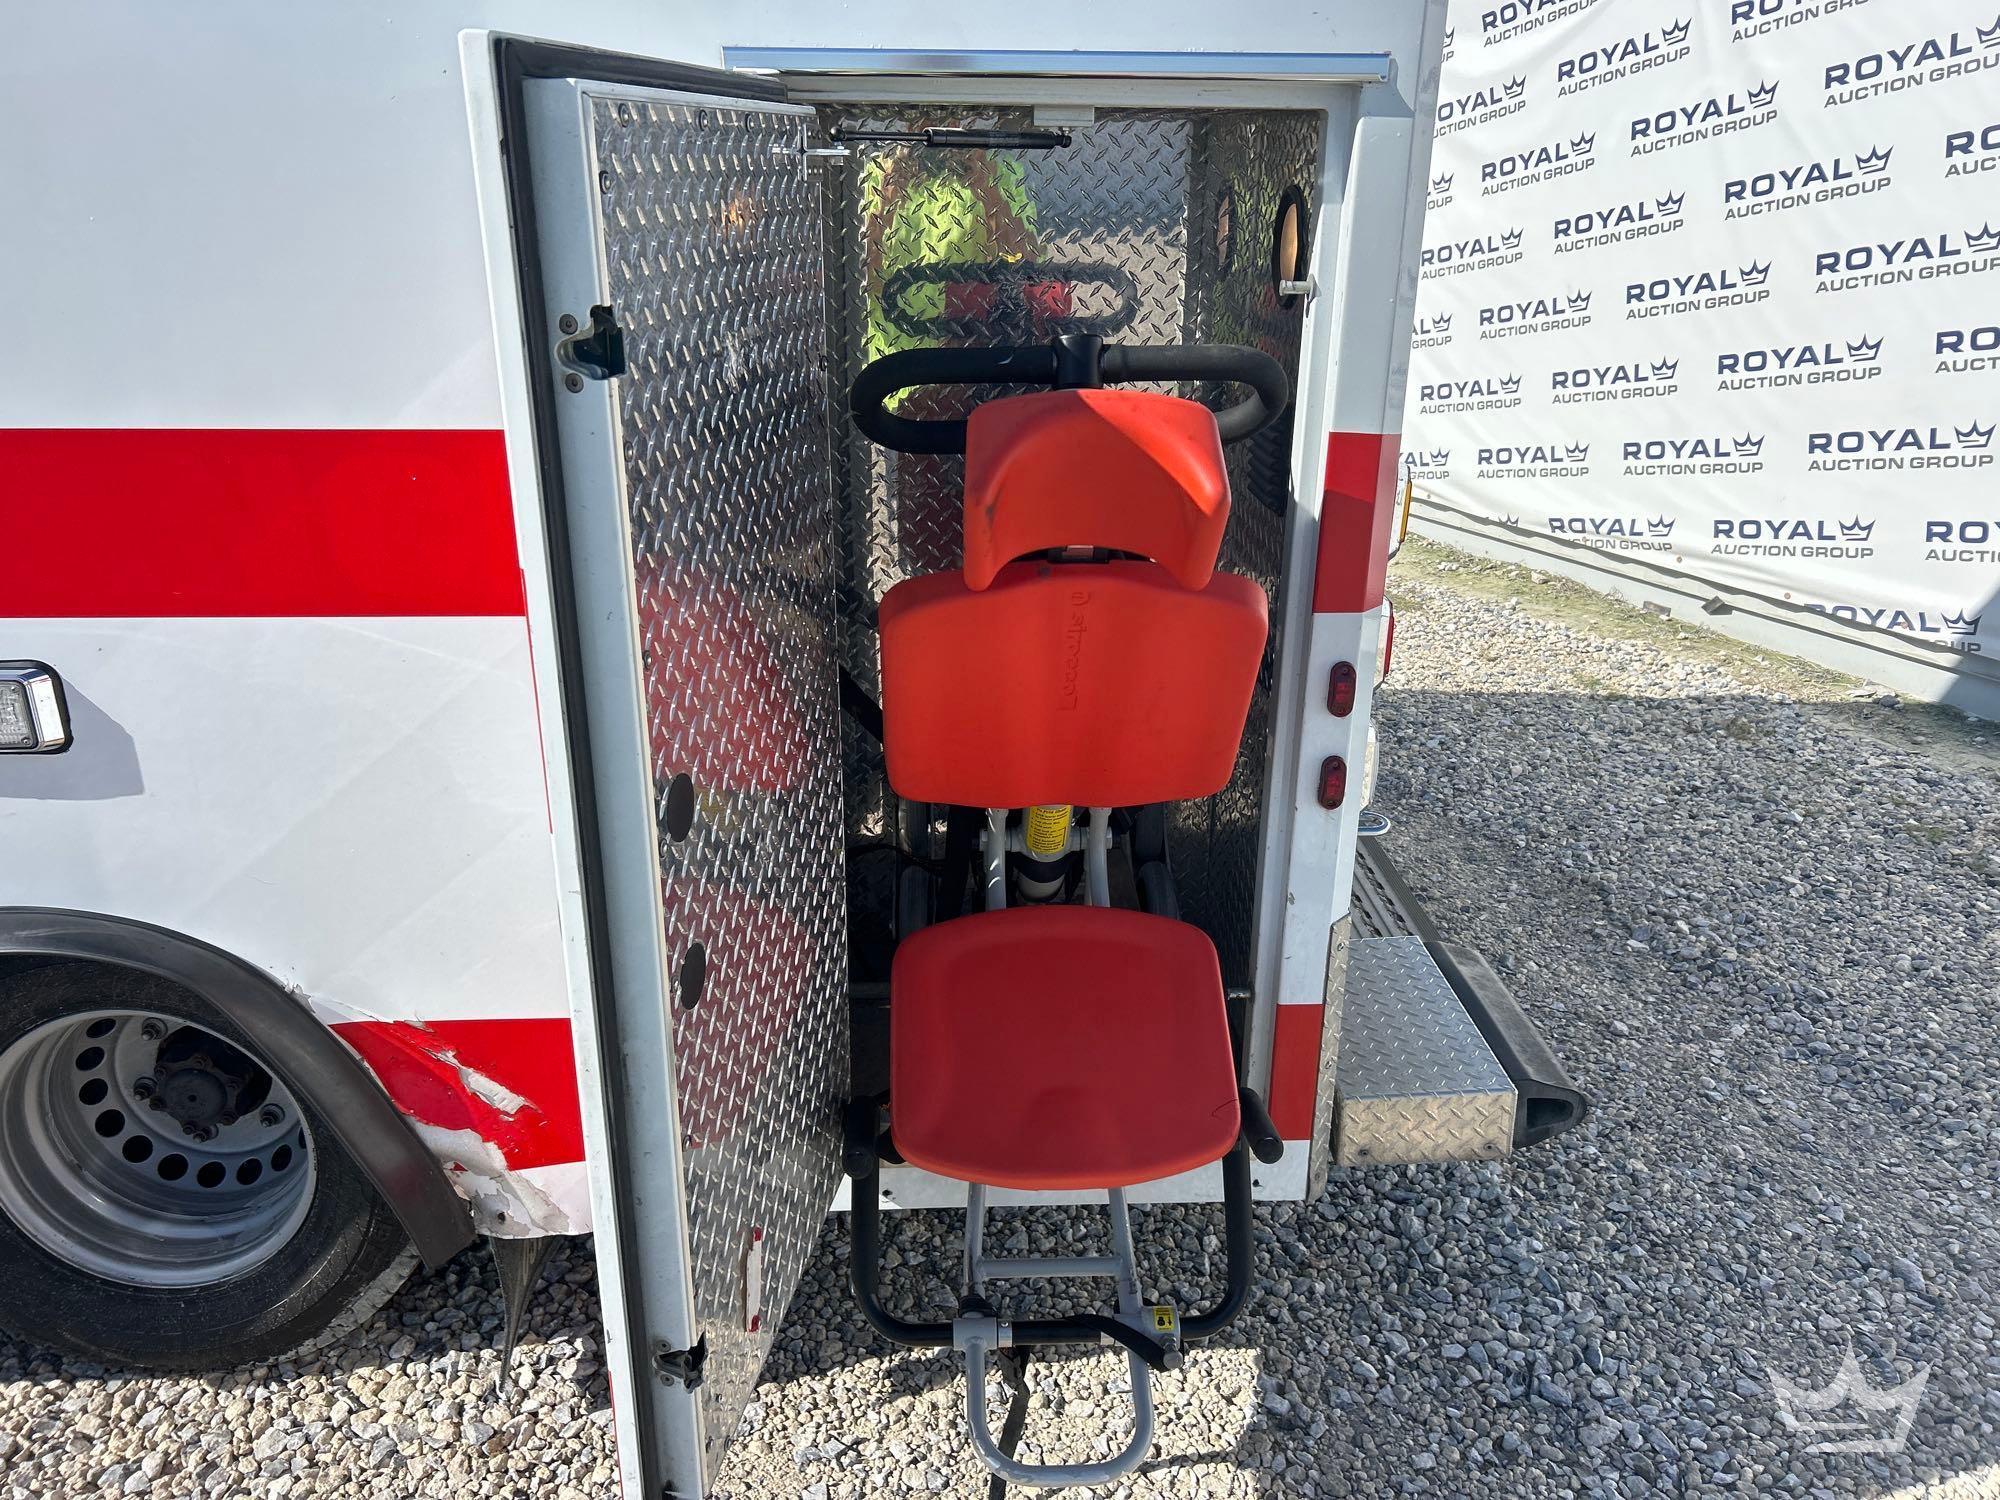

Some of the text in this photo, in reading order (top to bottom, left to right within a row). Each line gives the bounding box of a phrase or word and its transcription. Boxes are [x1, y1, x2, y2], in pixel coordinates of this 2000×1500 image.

[1484, 15, 1544, 47] AUCTION
[1732, 5, 1819, 43] AUCTION
[1557, 32, 1660, 82] ROYAL
[1558, 46, 1691, 98] AUCTION GROUP
[1824, 32, 1973, 90] ROYAL
[1823, 53, 2000, 109] AUCTION GROU
[1433, 100, 1526, 138] UCTION GROUP
[1438, 86, 1503, 122] OYAL
[1630, 93, 1745, 141] ROYAL
[1630, 109, 1778, 158] AUCTION GROUP
[1481, 142, 1569, 182] ROYAL
[1481, 157, 1595, 196] AUCTION GROUP
[1724, 158, 1853, 204] ROYAL
[1428, 196, 1453, 210] OUP
[1724, 176, 1891, 221] AUCTION GROUP
[1553, 201, 1654, 239] ROYAL
[1420, 235, 1500, 267] ROYAL
[1553, 218, 1684, 255] AUCTION GROUP
[1421, 252, 1523, 280] AUCTION GROUP
[1815, 233, 1961, 276] ROYAL
[1626, 269, 1737, 305] ROYAL
[1815, 257, 2000, 294] AUCTION GROUP
[1479, 297, 1566, 326] ROYAL
[1626, 289, 1770, 320] AUCTION GROUP
[1412, 336, 1452, 349] GROUP
[1479, 315, 1592, 340] AUCTION GROUP
[1717, 343, 1844, 374] ROYAL
[1935, 356, 2000, 373] AUCT
[1420, 378, 1499, 401] ROYAL
[1552, 363, 1649, 389] ROYAL
[1717, 366, 1882, 391] AUCTION GROUP
[1420, 398, 1522, 414] AUCTION GROUP
[1552, 384, 1678, 404] AUCTION GROUP
[1478, 445, 1564, 465] ROYAL
[1623, 438, 1731, 460] ROYAL
[1808, 427, 1951, 454] ROYAL
[1477, 467, 1589, 478] AUCTION GROUP
[1623, 462, 1763, 476] AUCTION GROUP
[1808, 454, 1994, 471] AUCTION GROUP
[1548, 518, 1644, 536] ROYAL
[1713, 519, 1836, 541] ROYAL
[1620, 540, 1673, 551] GROUP
[1711, 544, 1874, 559] AUCTION GROUP
[1925, 549, 2000, 562] AUCTI
